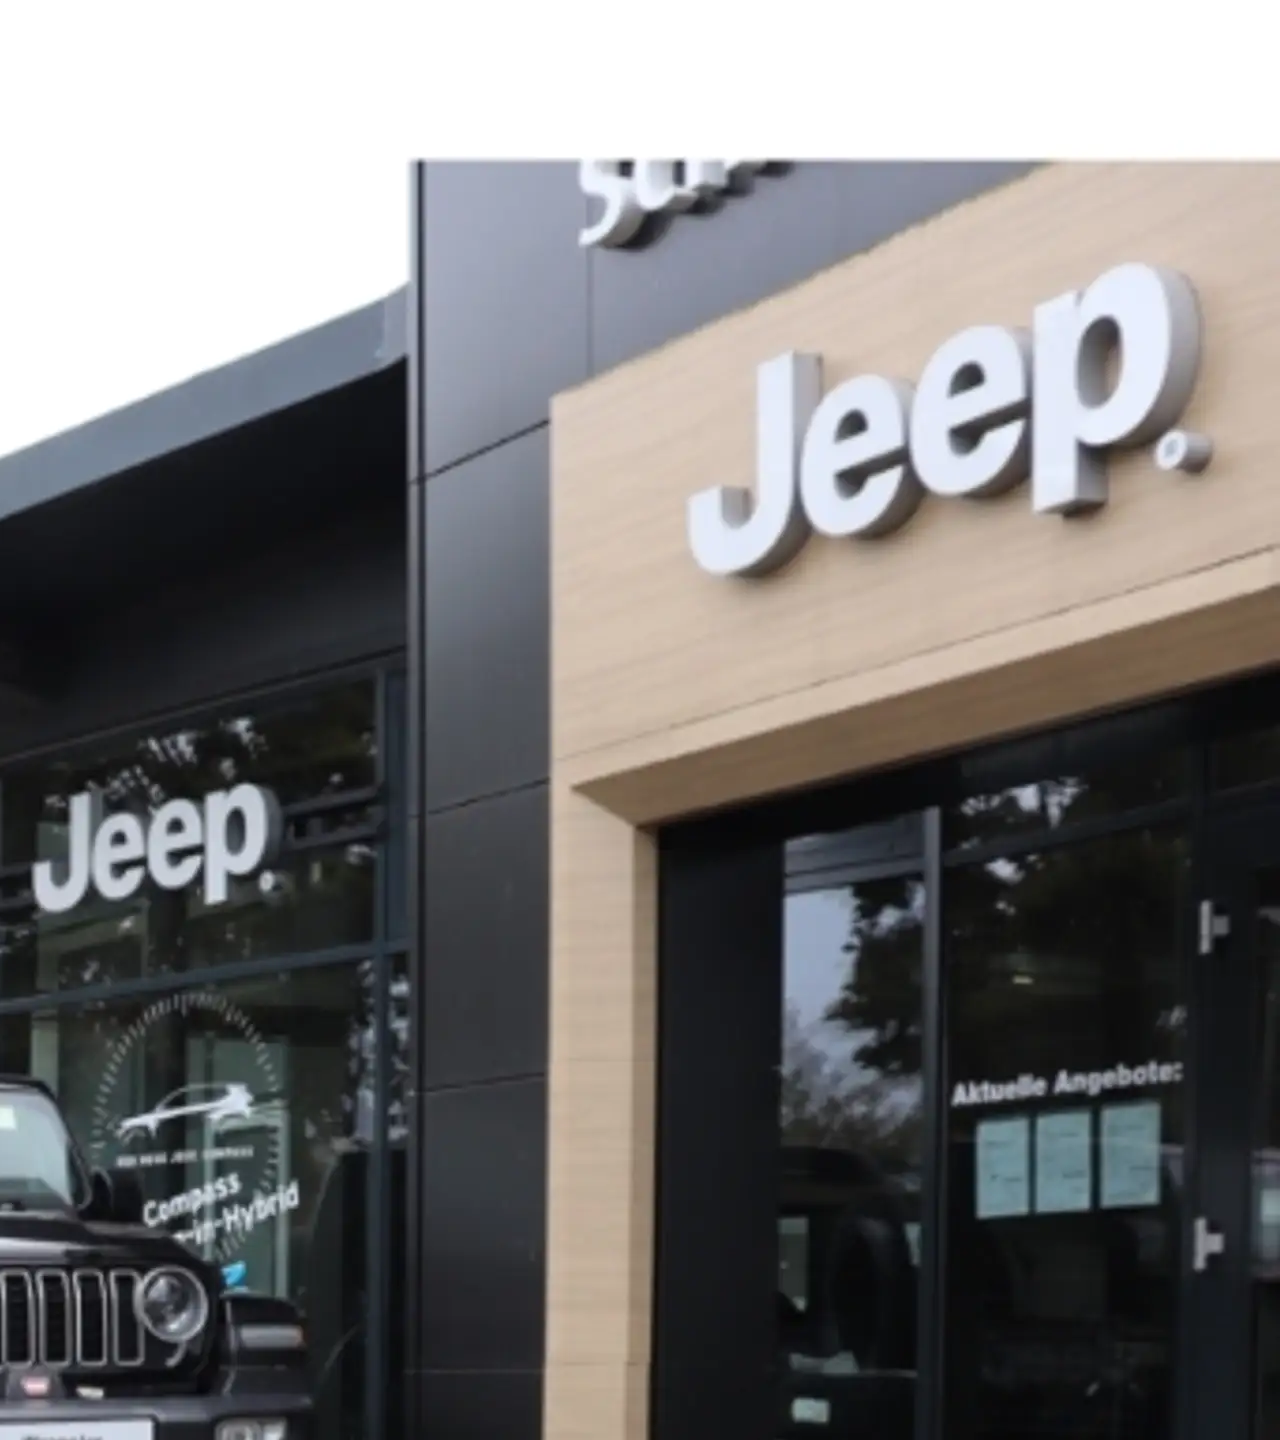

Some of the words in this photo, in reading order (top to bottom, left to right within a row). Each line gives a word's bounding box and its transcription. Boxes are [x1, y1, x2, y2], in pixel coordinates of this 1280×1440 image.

[686, 261, 1197, 578] Jeep
[31, 781, 272, 914] Jeep
[950, 1073, 1049, 1107] Aktuelle
[1053, 1059, 1185, 1096] Angebote:
[143, 1172, 243, 1228] Compass
[171, 1180, 300, 1244] -in-Hybrid
